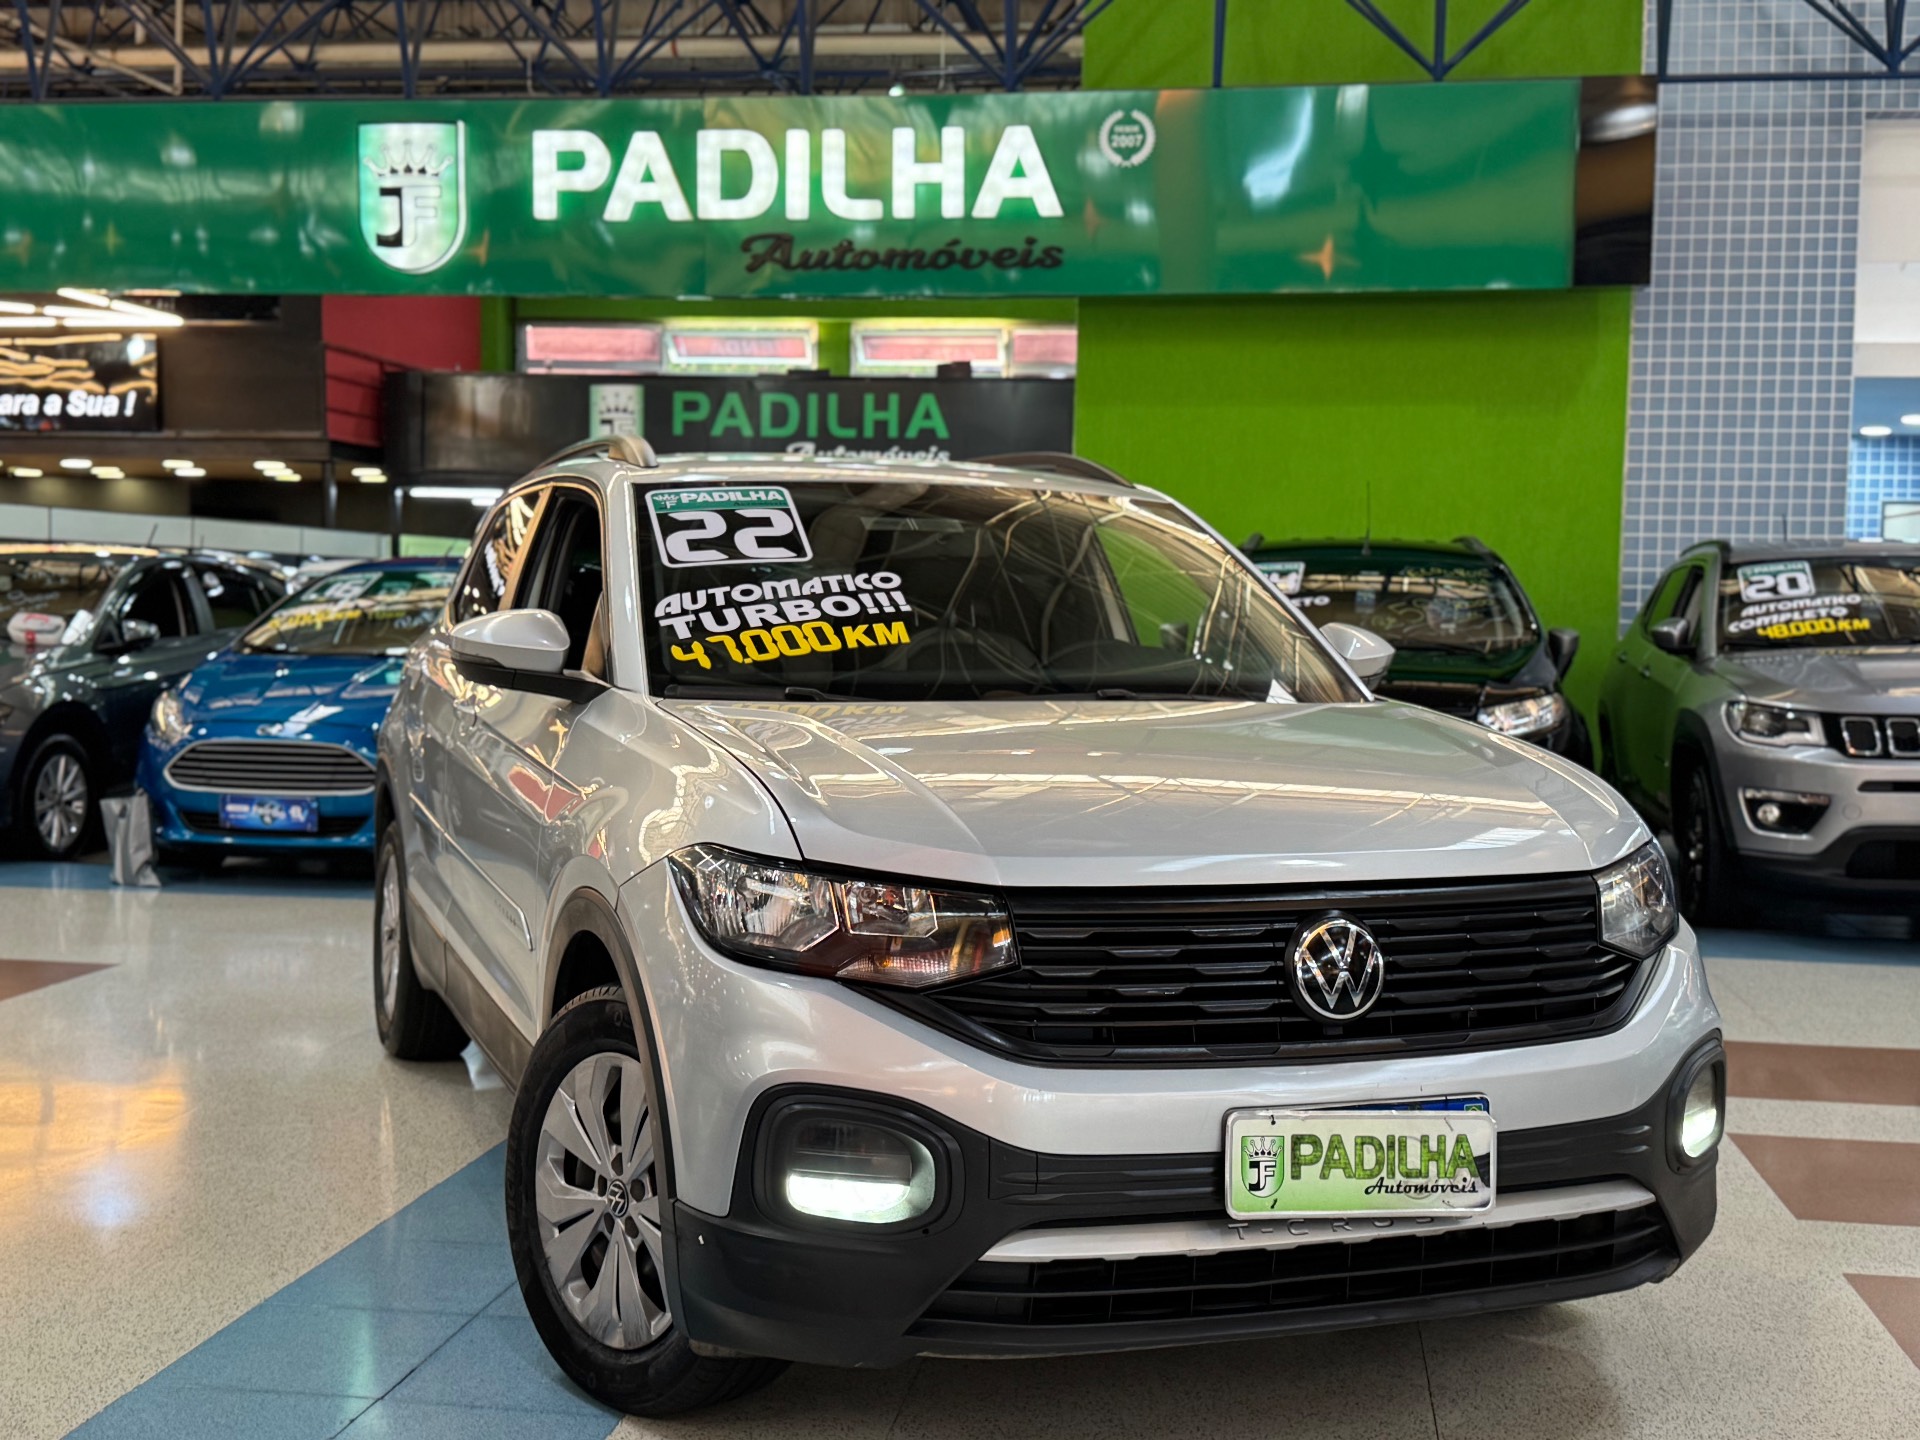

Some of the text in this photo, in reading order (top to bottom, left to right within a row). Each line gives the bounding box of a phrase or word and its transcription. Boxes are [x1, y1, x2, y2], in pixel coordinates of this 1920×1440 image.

[1111, 134, 1144, 148] 2007
[532, 124, 1065, 222] PADILHA
[741, 235, 1065, 273] Automóveis
[43, 393, 63, 417] a
[66, 389, 120, 417] Sua
[671, 390, 951, 440] PADILHA
[680, 490, 785, 504] PADILHA
[665, 509, 798, 562] 22
[1745, 572, 1810, 598] 20
[659, 591, 912, 640] TURBO!!!
[1728, 606, 1849, 633] COMPLETO
[1756, 617, 1871, 640] 48.000 KM
[671, 621, 911, 670] 47.000 KM
[1290, 1133, 1479, 1181] PADILHA
[1364, 1177, 1479, 1196] Automóveis
